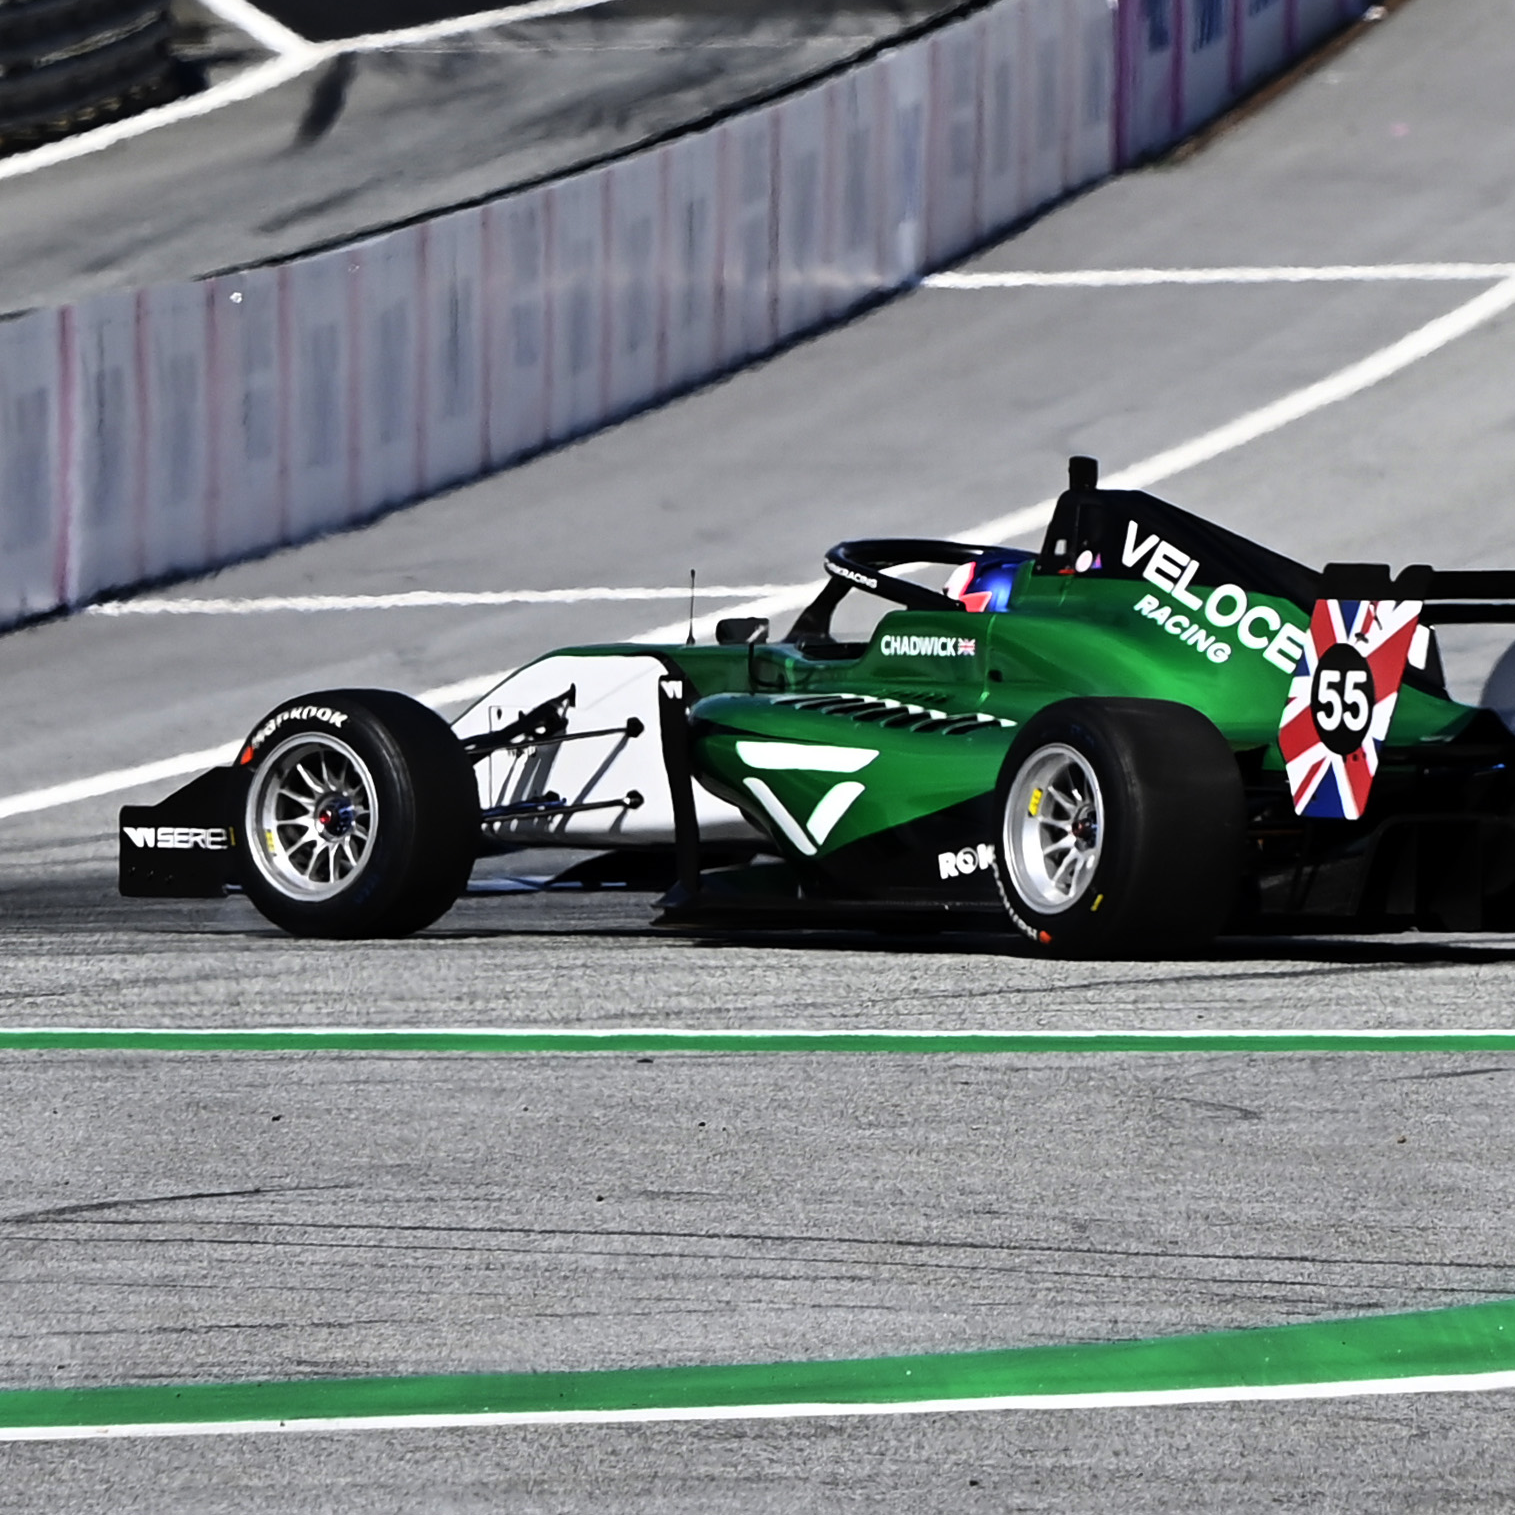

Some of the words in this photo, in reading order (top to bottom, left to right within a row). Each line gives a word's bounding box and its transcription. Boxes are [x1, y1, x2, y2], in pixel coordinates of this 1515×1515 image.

[1121, 519, 1304, 675] VELOCE
[1133, 593, 1232, 664] RACING
[880, 634, 957, 657] CHADWICK
[1316, 669, 1370, 732] 55
